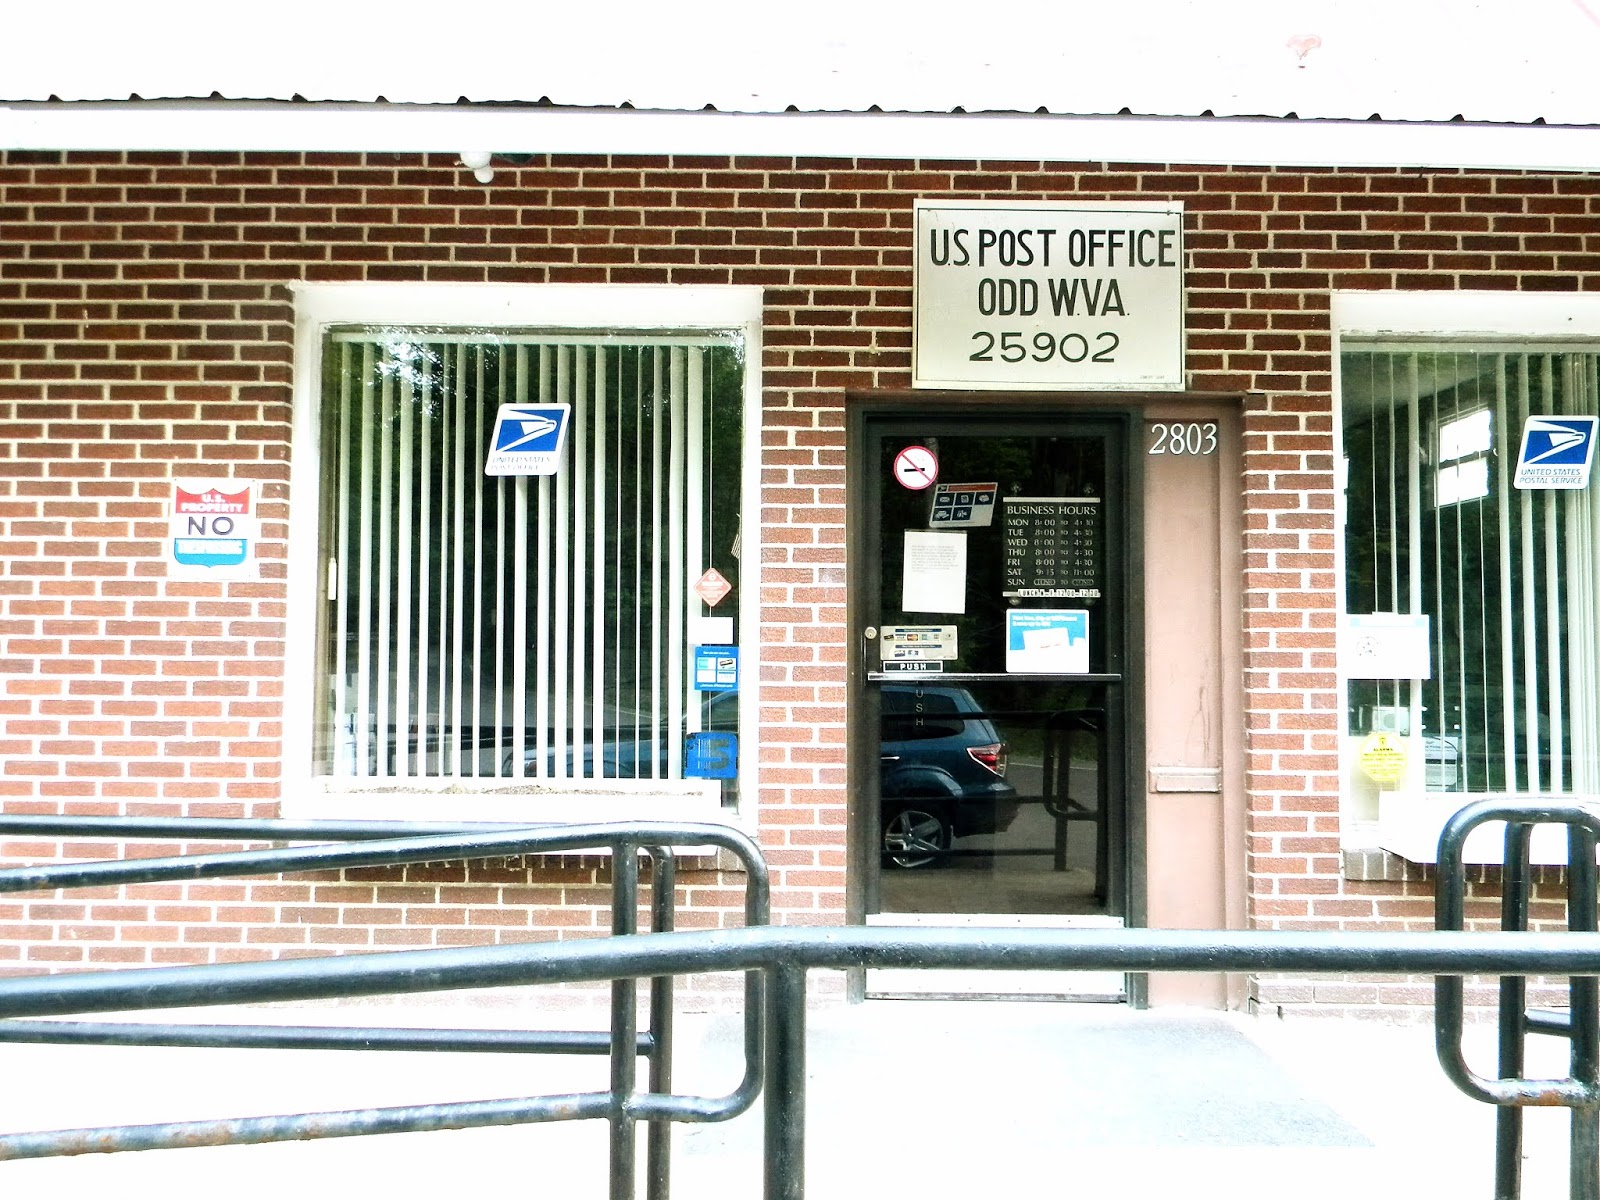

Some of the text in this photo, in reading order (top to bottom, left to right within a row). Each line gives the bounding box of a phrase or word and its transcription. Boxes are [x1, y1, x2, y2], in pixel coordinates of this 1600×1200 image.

[930, 229, 1176, 267] U.S. POST OFFICE
[978, 278, 1038, 316] ODD
[969, 331, 1120, 363] 25902
[1148, 422, 1217, 456] 2803
[181, 502, 243, 512] PROPERTY
[1007, 505, 1096, 515] BUSINESS HOURS
[187, 516, 235, 536] NO
[1007, 578, 1025, 586] SUN
[915, 681, 924, 726] USH
